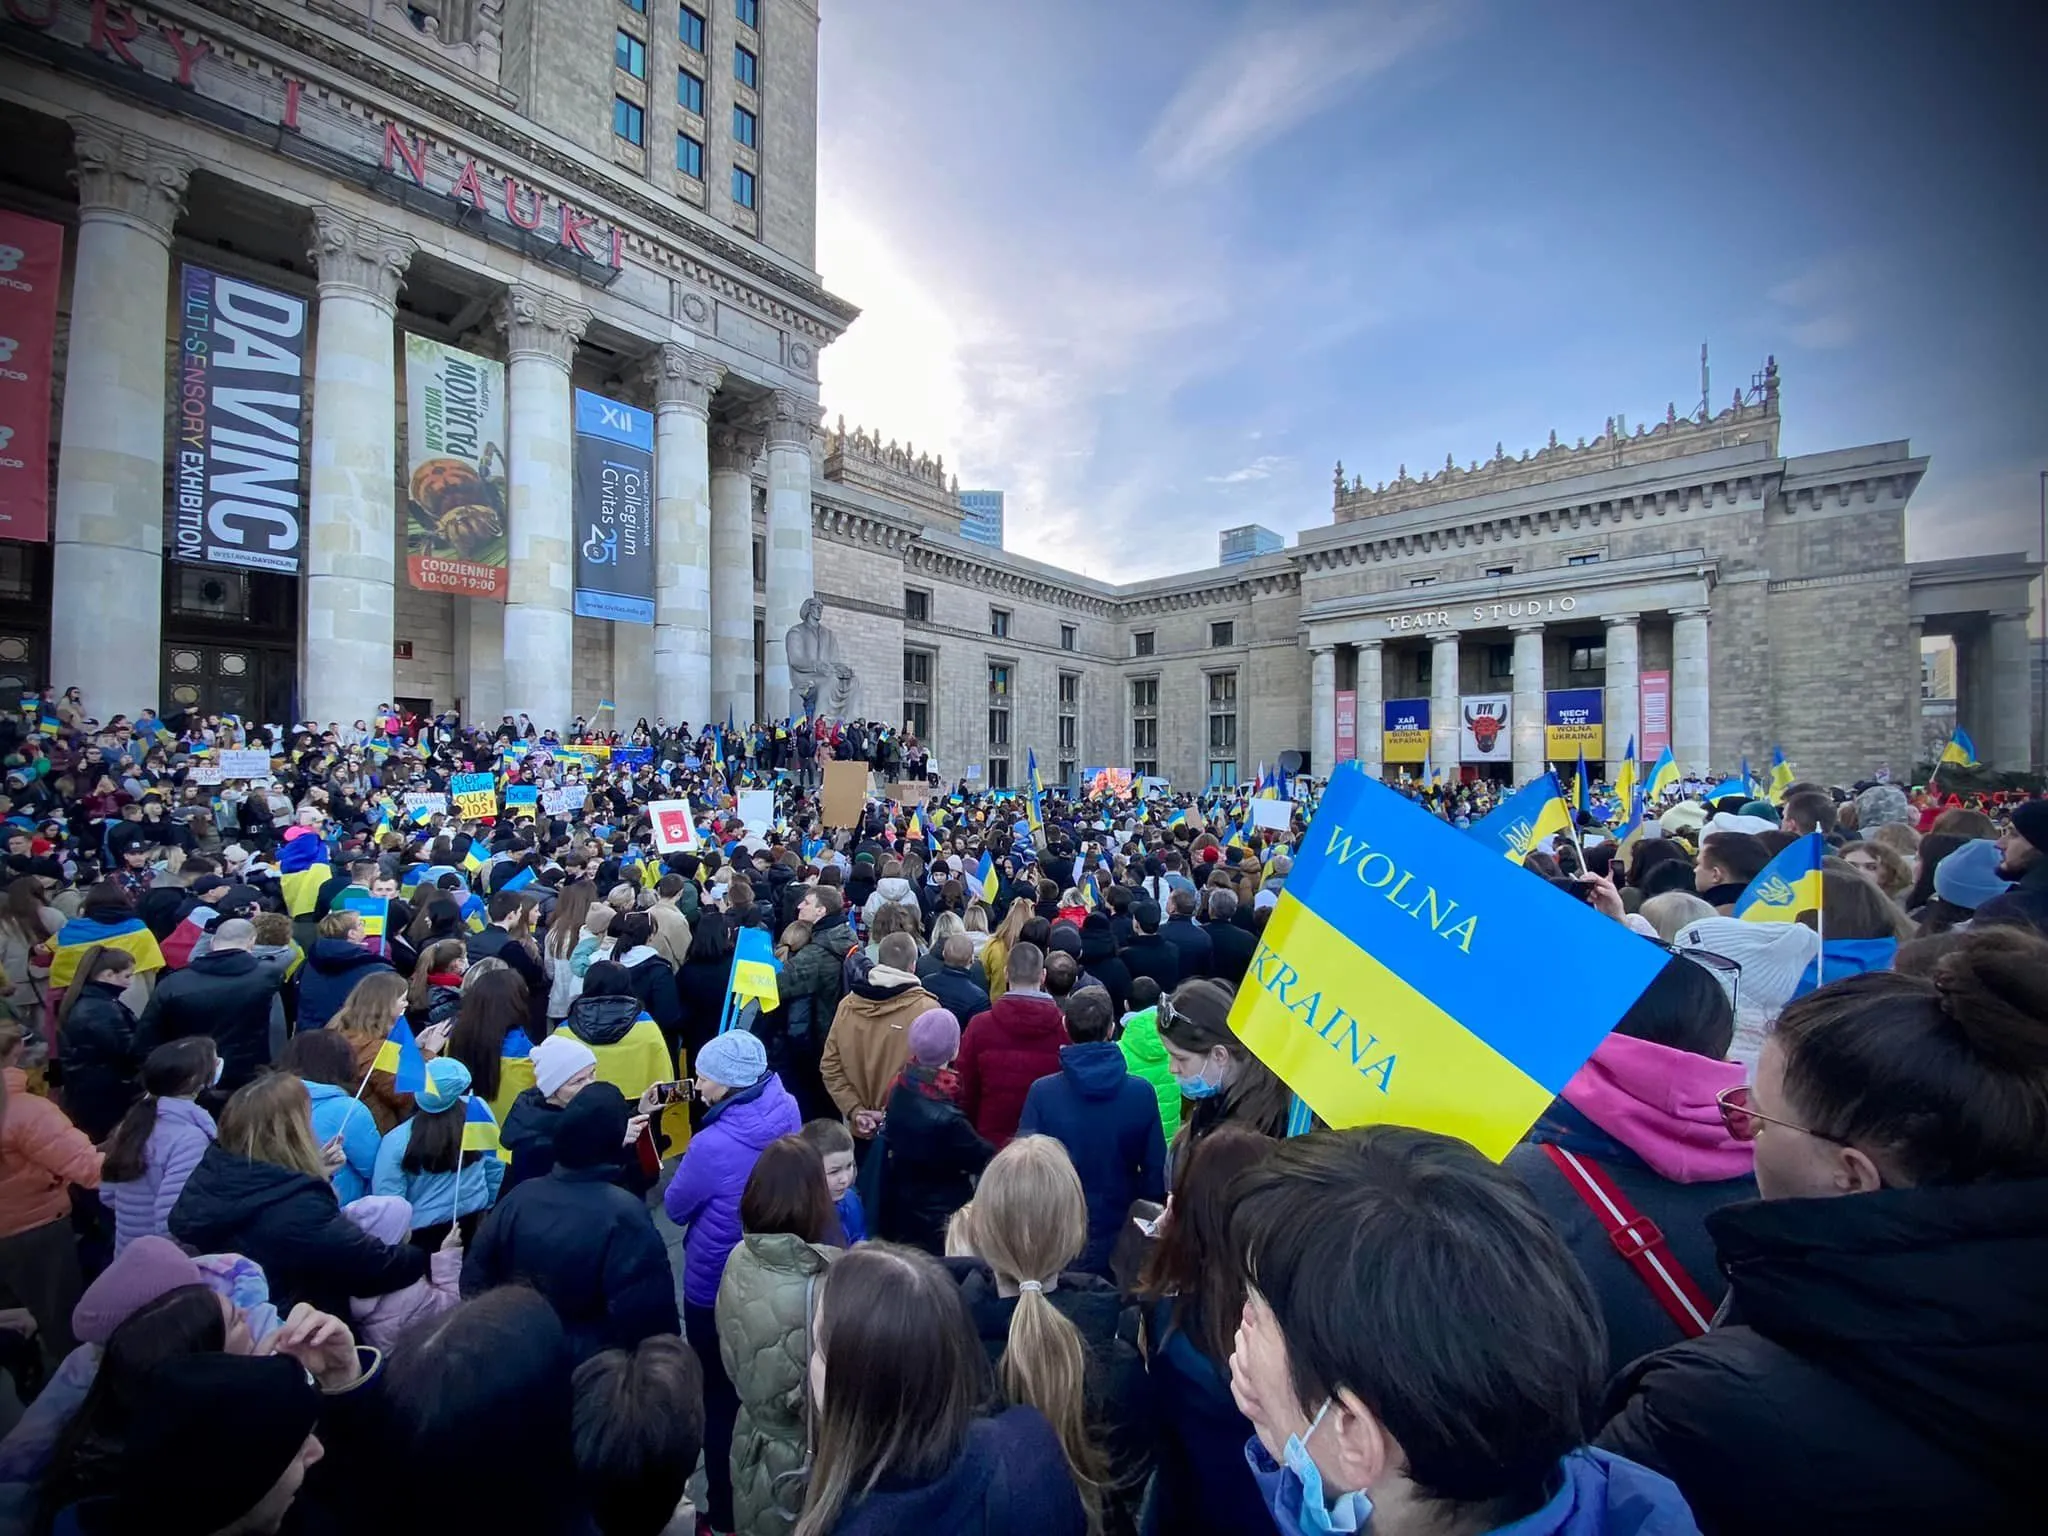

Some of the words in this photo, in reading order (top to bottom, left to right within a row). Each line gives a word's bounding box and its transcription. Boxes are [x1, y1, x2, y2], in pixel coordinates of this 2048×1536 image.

[280, 79, 306, 131] I
[381, 118, 629, 271] NAUKI
[181, 268, 210, 449] MULTI-SENSORY
[424, 385, 443, 452] WYSTAWA
[435, 355, 484, 460] PAJĄKÓW
[177, 451, 205, 559] EXHIBITION
[601, 468, 619, 524] Civitas
[620, 473, 643, 556] Collegium
[419, 571, 496, 591] 10:00-19:00
[420, 558, 496, 580] CODZIENNIE
[1386, 611, 1449, 631] TEATR
[1473, 597, 1576, 621] STUDIO
[1398, 715, 1415, 724] ХАЙ
[1559, 709, 1589, 717] NIECH
[1562, 715, 1586, 725] ŻYJE
[1552, 732, 1598, 740] UKRAINA!
[452, 775, 480, 785] STOP
[459, 781, 493, 793] KILLING
[456, 791, 487, 805] OUR
[1325, 824, 1477, 955] WOLNA
[1249, 940, 1398, 1095] KRAINA
